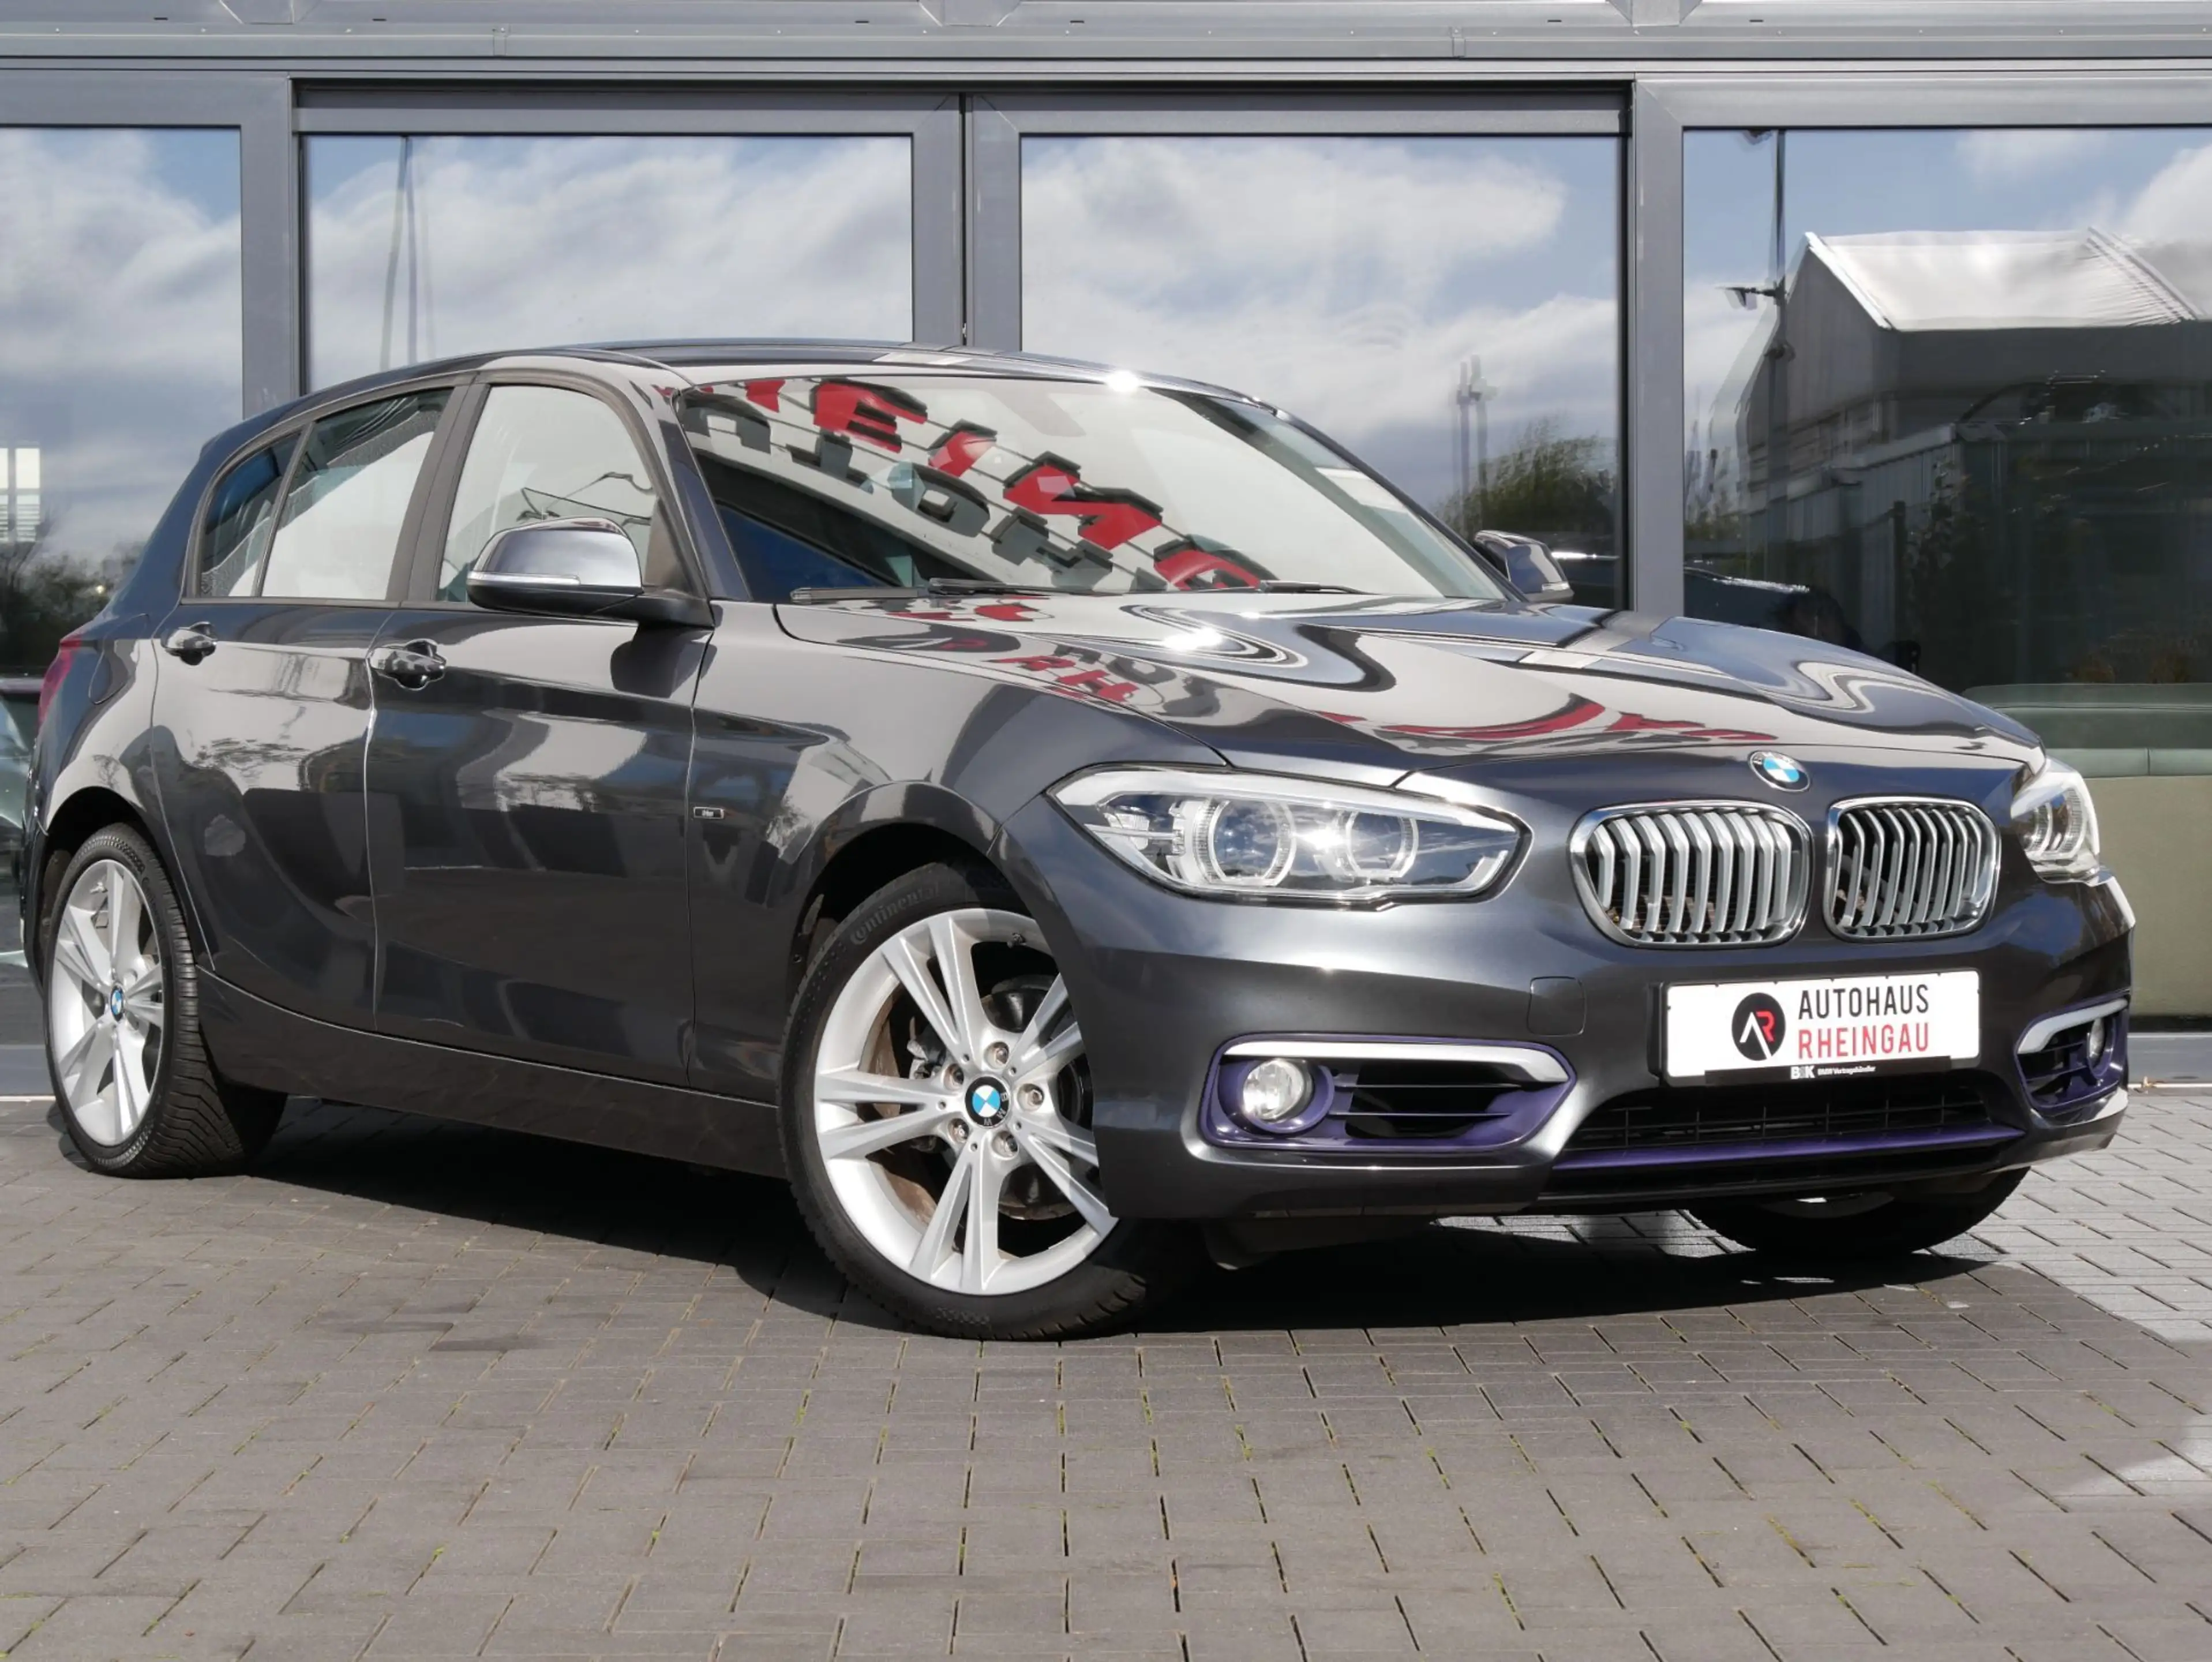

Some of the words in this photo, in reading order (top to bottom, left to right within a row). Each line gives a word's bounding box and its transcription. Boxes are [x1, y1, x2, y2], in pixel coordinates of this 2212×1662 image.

[850, 884, 940, 945] Continental
[1798, 984, 1929, 1020] AUTOHAUS
[1798, 1023, 1929, 1059] RHEINGAU
